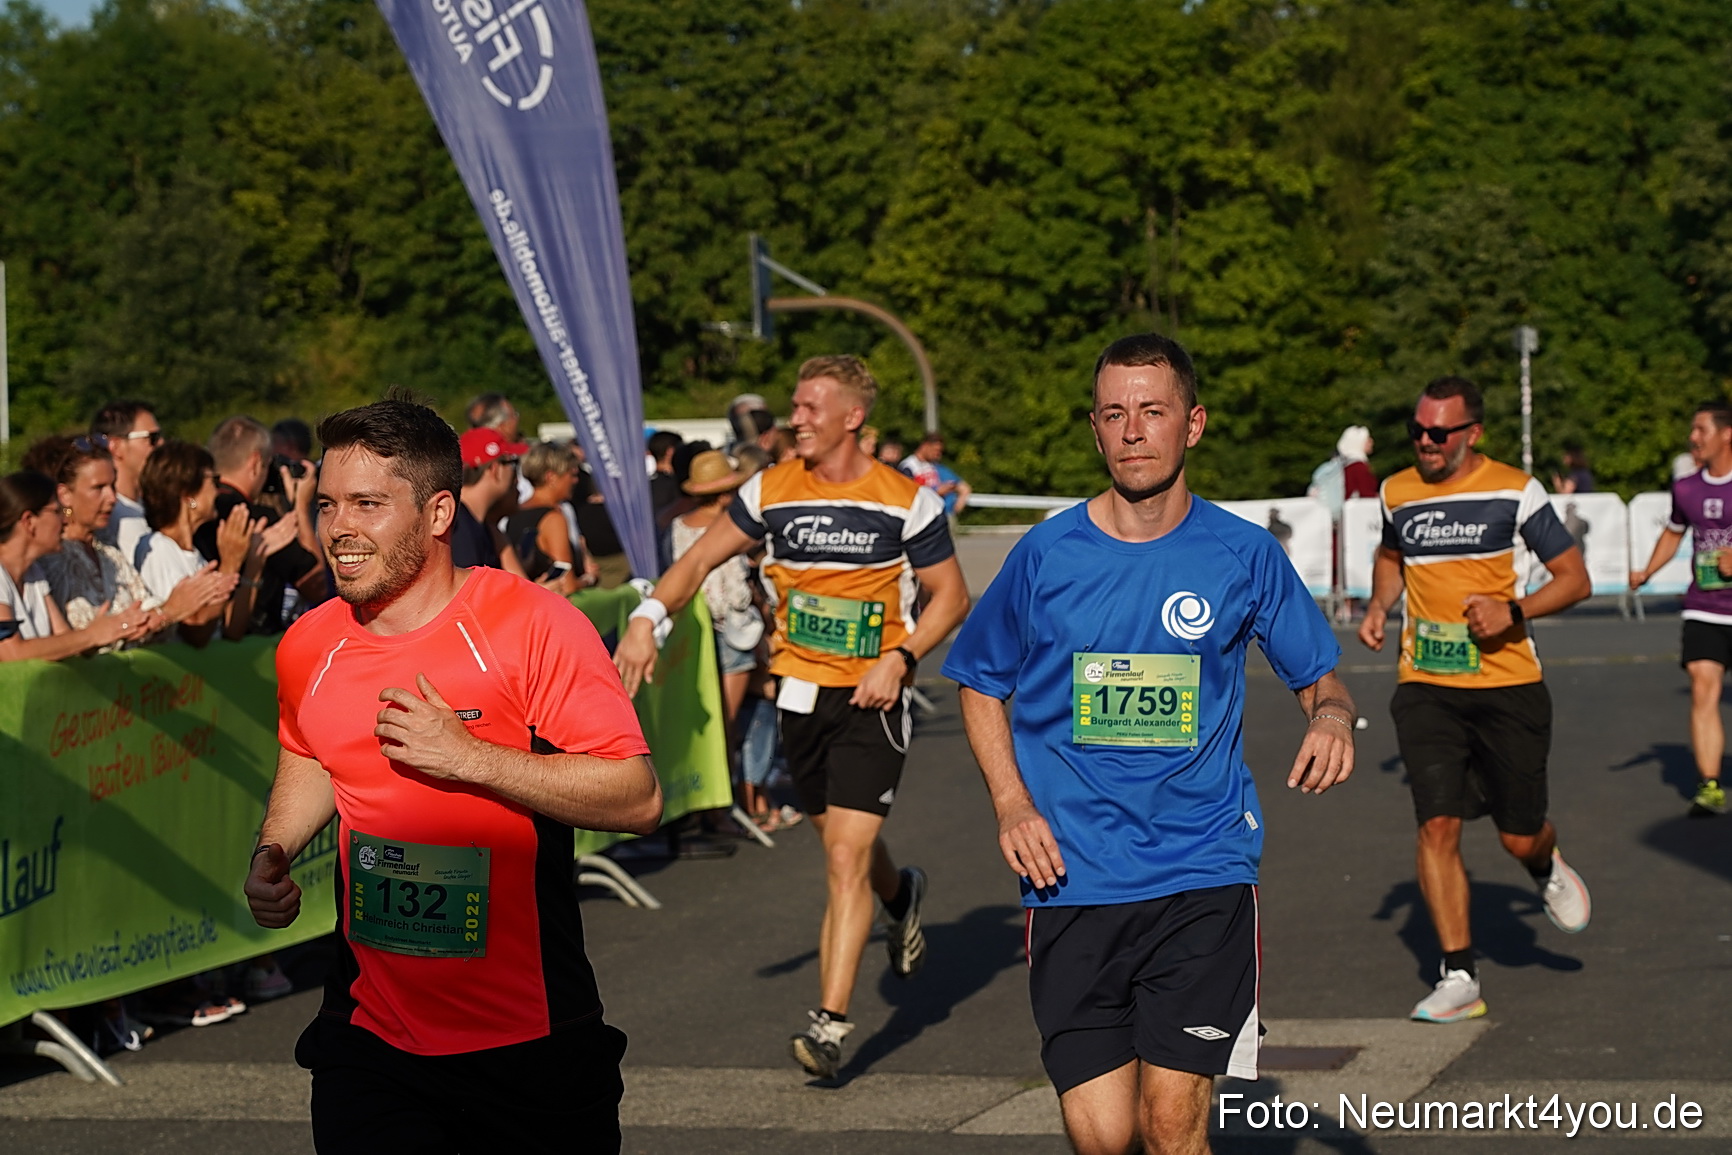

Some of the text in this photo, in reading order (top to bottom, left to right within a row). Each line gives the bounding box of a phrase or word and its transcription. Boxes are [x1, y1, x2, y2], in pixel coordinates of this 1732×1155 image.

[797, 528, 880, 545] Fischer
[1414, 521, 1488, 540] Fischer
[804, 544, 873, 554] AUTOMOBILE
[1420, 537, 1481, 547] AUTOMOBILE
[798, 611, 847, 637] 1825
[1423, 639, 1468, 658] 1824
[1105, 670, 1145, 679] Firmenlauf
[1080, 694, 1091, 726] RUN
[1095, 685, 1178, 716] 1759
[50, 682, 134, 758] Gesunde
[1181, 691, 1193, 733] 2022
[1091, 717, 1181, 728] Burgardt Alexander
[377, 859, 420, 871] Firmenlauf
[355, 882, 364, 921] RUN
[376, 878, 448, 920] 132
[464, 892, 480, 942] 2022
[412, 921, 464, 934] Christian
